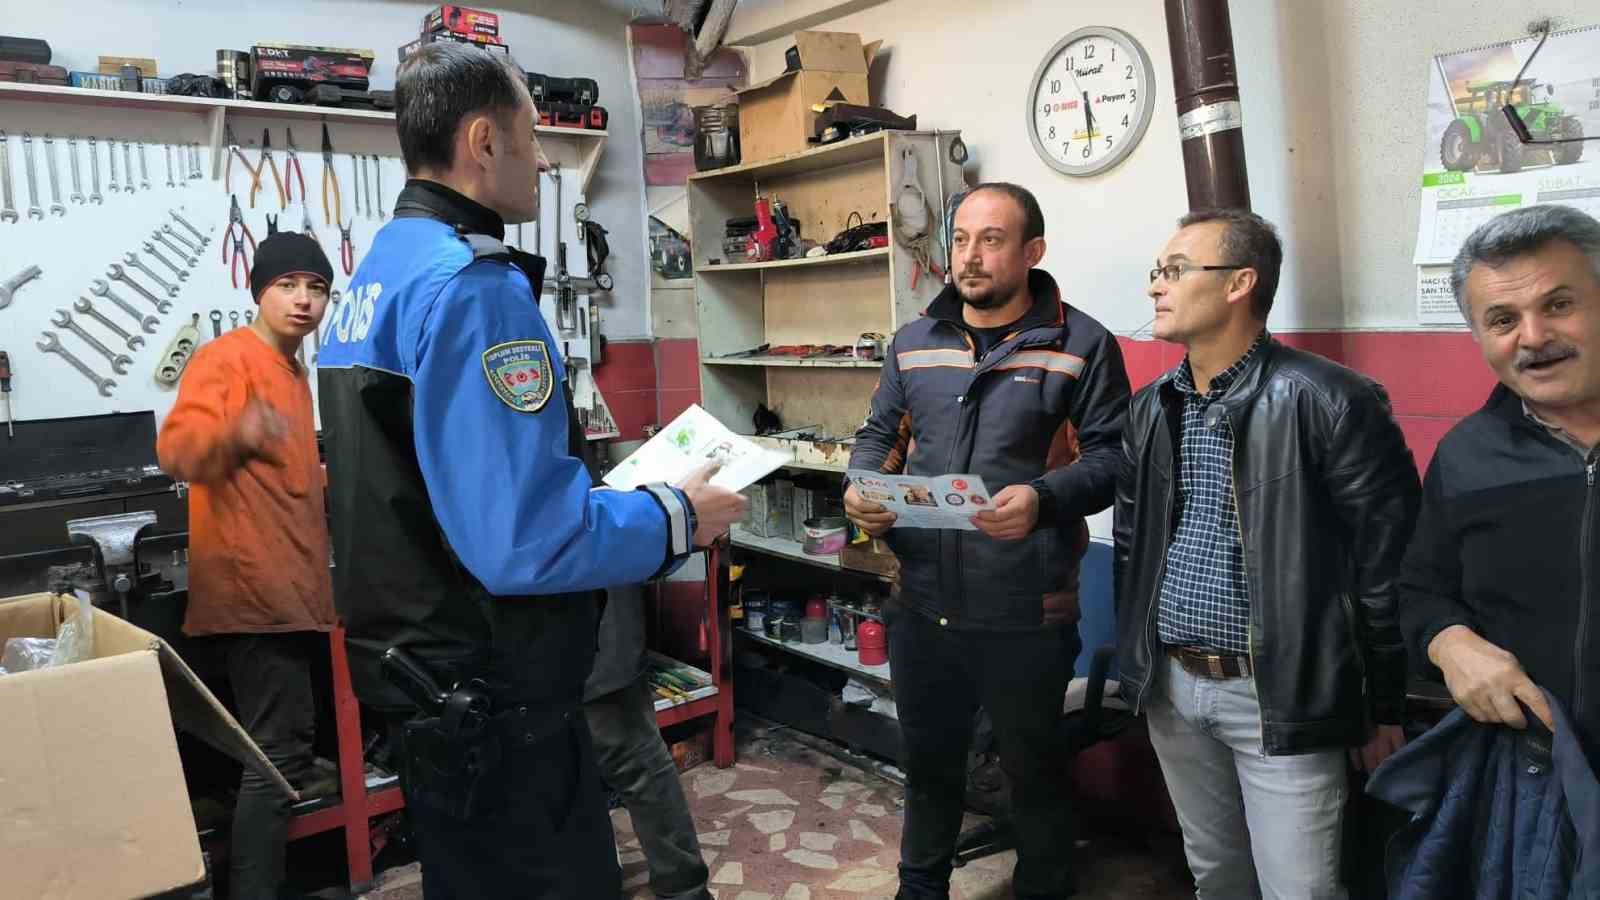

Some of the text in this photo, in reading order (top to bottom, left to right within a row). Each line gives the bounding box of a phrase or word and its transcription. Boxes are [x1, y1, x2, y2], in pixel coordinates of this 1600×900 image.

[1084, 44, 1095, 59] 12
[1111, 48, 1115, 61] 1
[1065, 57, 1074, 71] 11
[1125, 65, 1133, 79] 2
[1050, 80, 1061, 94] 10
[1101, 94, 1126, 103] Payen
[1129, 89, 1137, 103] 3
[1043, 104, 1051, 117] 9
[1121, 113, 1129, 128] 4
[1048, 126, 1056, 139] 8
[1062, 142, 1070, 155] 7
[1105, 136, 1113, 149] 5
[1082, 145, 1090, 158] 6
